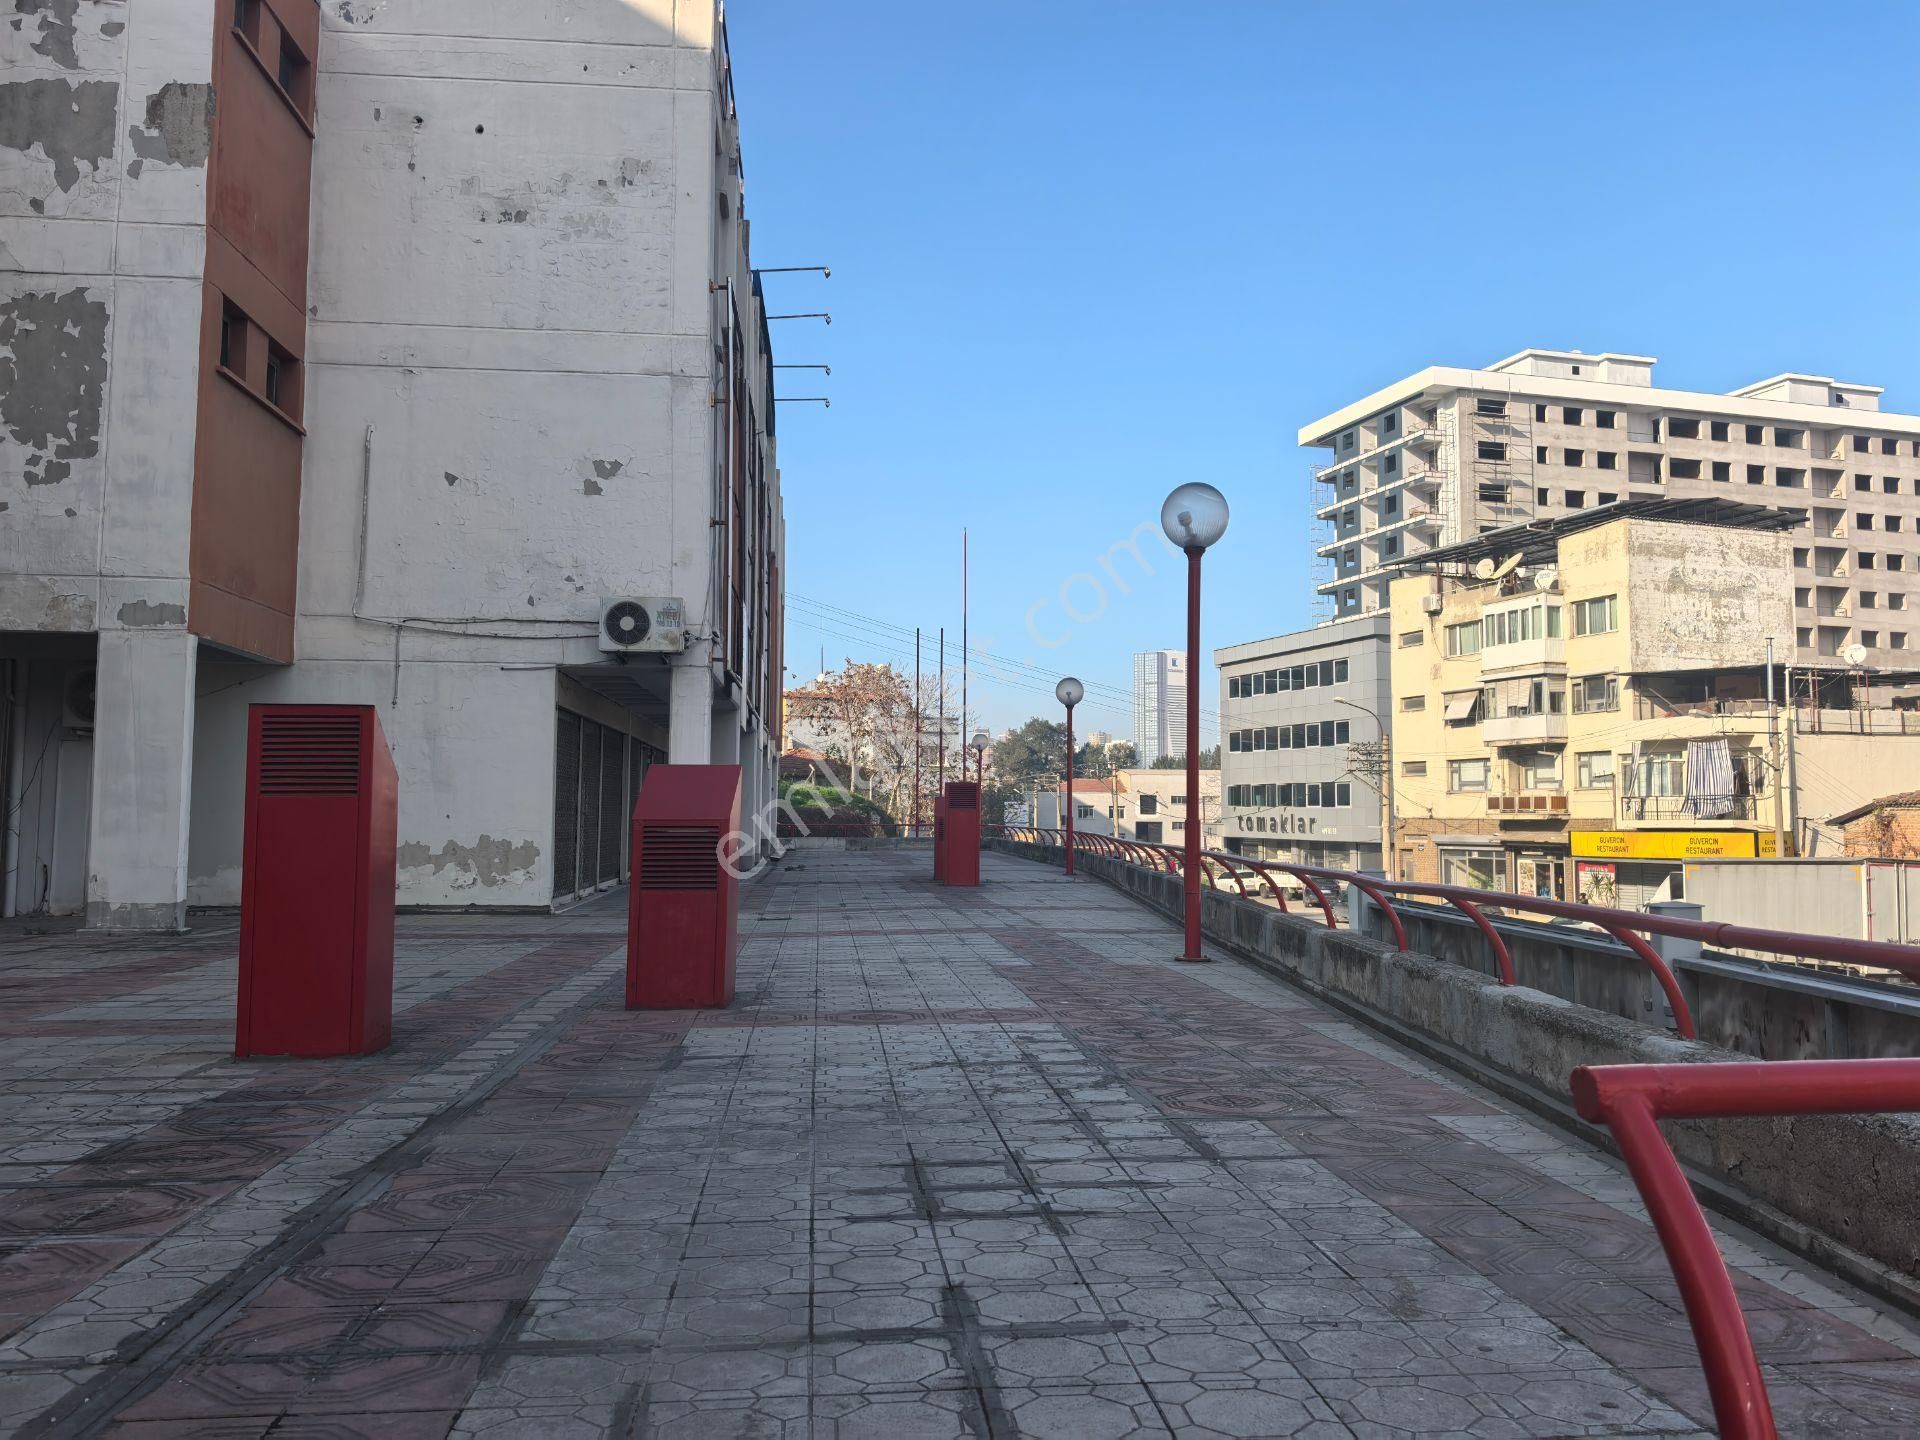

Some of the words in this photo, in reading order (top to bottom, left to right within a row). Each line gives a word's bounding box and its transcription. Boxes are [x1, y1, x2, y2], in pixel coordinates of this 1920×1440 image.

[1237, 813, 1317, 834] tomaklar
[1596, 845, 1630, 853] RESTAURANT
[1685, 846, 1724, 855] RESTAURANT
